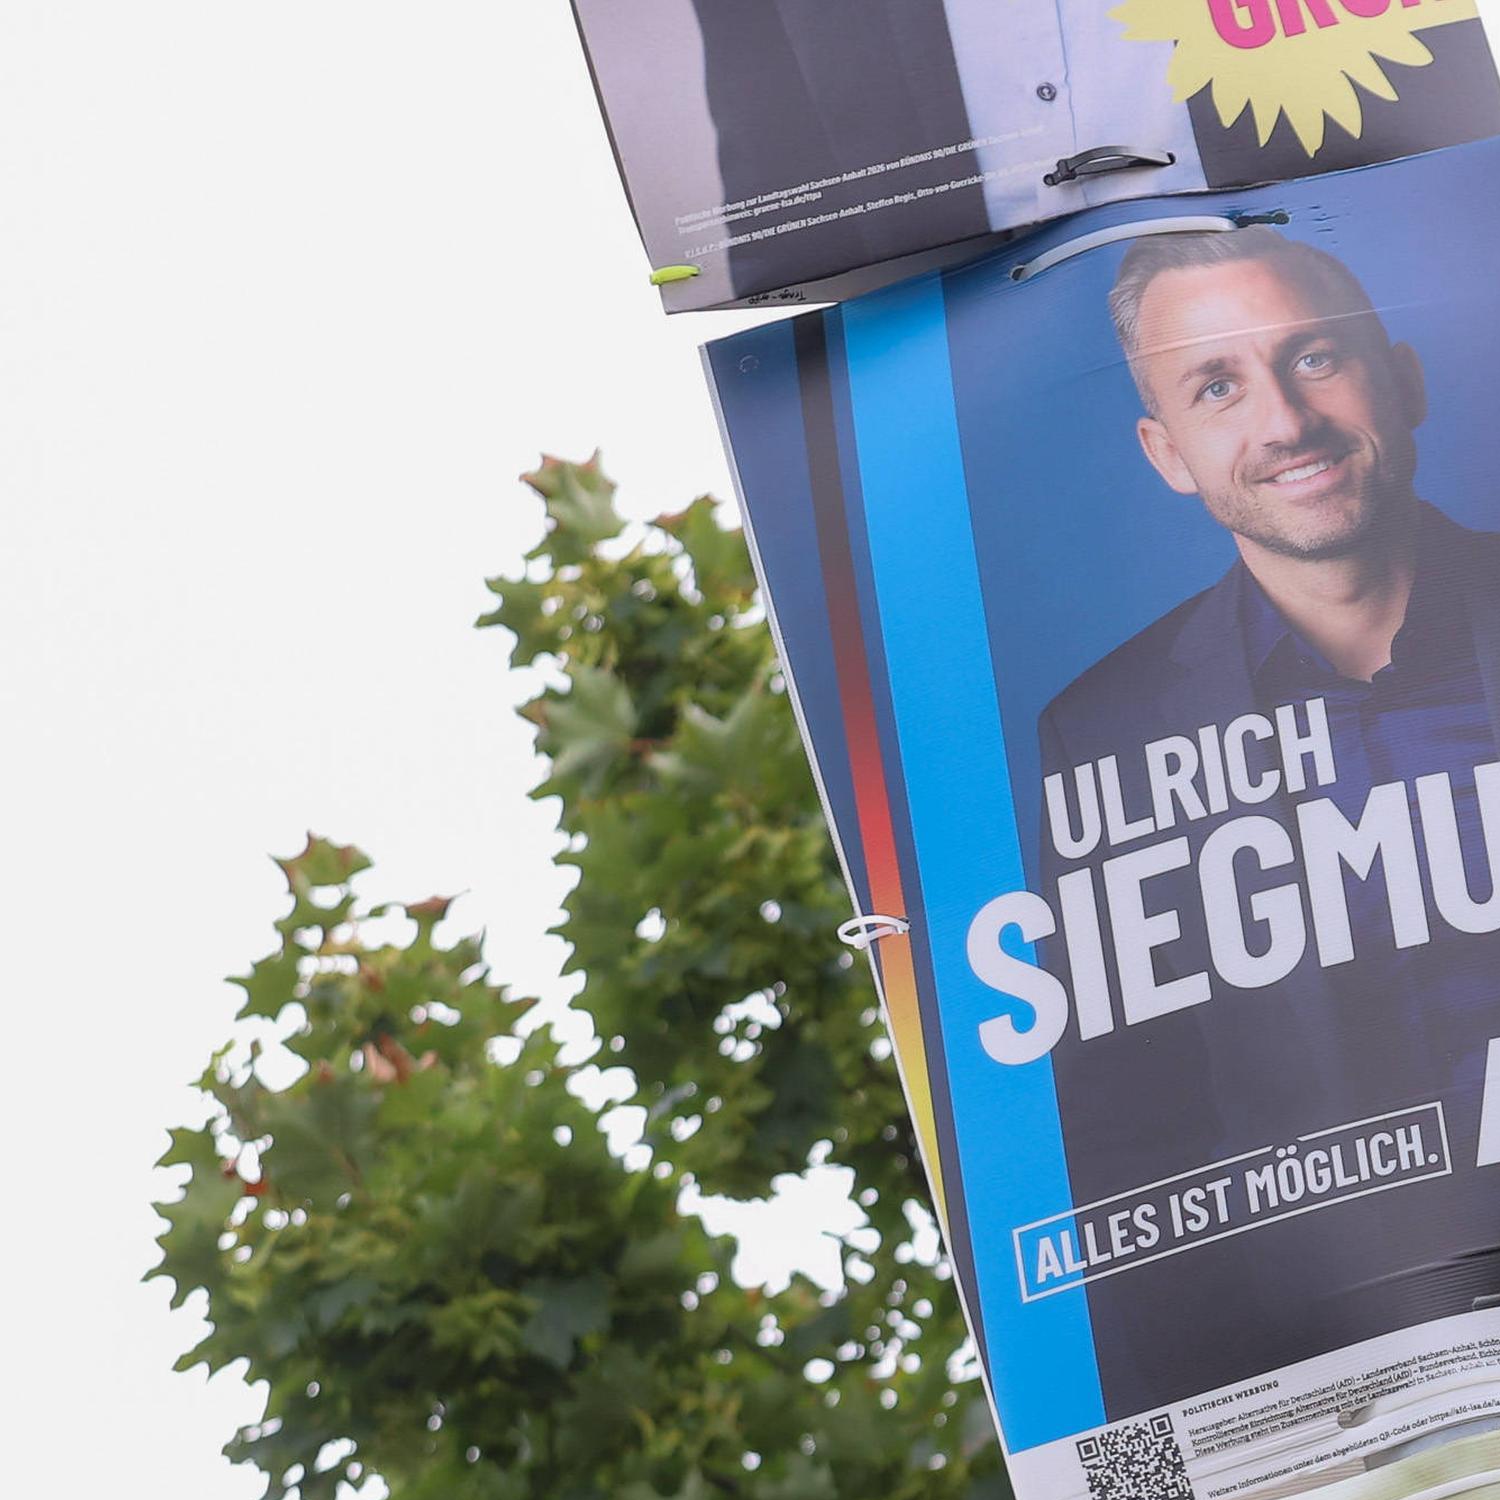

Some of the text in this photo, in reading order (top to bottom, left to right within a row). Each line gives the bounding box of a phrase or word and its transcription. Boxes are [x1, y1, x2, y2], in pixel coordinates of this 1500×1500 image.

[757, 184, 809, 203] Landtagswahl
[809, 168, 867, 190] Sachsen-Anhalt
[867, 163, 886, 175] 2026
[886, 161, 900, 170] von
[900, 151, 932, 168] BÜNDNIS
[777, 219, 807, 234] GRÜNEN
[866, 197, 894, 211] Steffen
[1043, 697, 1337, 859] ULRICH
[1034, 1124, 1440, 1284] ALLES IST MÖGLICH.
[1182, 1380, 1279, 1417] POLITISCHE WERBUNG
[1192, 1423, 1249, 1446] Kontrollierende
[1295, 1396, 1335, 1414] Alternative
[1335, 1391, 1347, 1401] für
[1347, 1375, 1393, 1397] Deutschland
[1393, 1368, 1412, 1383] (AfD)
[1238, 1402, 1278, 1421] Alternative
[1278, 1399, 1290, 1408] für
[1290, 1383, 1336, 1404] Deutschland
[1336, 1376, 1356, 1390] (AfD)
[1361, 1355, 1417, 1380] Landesverband
[1194, 1445, 1215, 1457] Diese
[1215, 1432, 1251, 1449] Werbung
[1250, 1427, 1269, 1439] steht
[1269, 1424, 1280, 1433] im
[1280, 1405, 1341, 1429] Zusammenhang
[1340, 1399, 1354, 1410] mit
[1354, 1395, 1367, 1405] der
[1207, 1484, 1238, 1498] Weitere
[1237, 1467, 1293, 1489] Informationen
[1293, 1459, 1314, 1471] unter
[1315, 1453, 1331, 1463] dem
[1332, 1436, 1379, 1457] abgebildeten
[1379, 1423, 1411, 1440] QR-Code
[1411, 1418, 1428, 1429] oder
